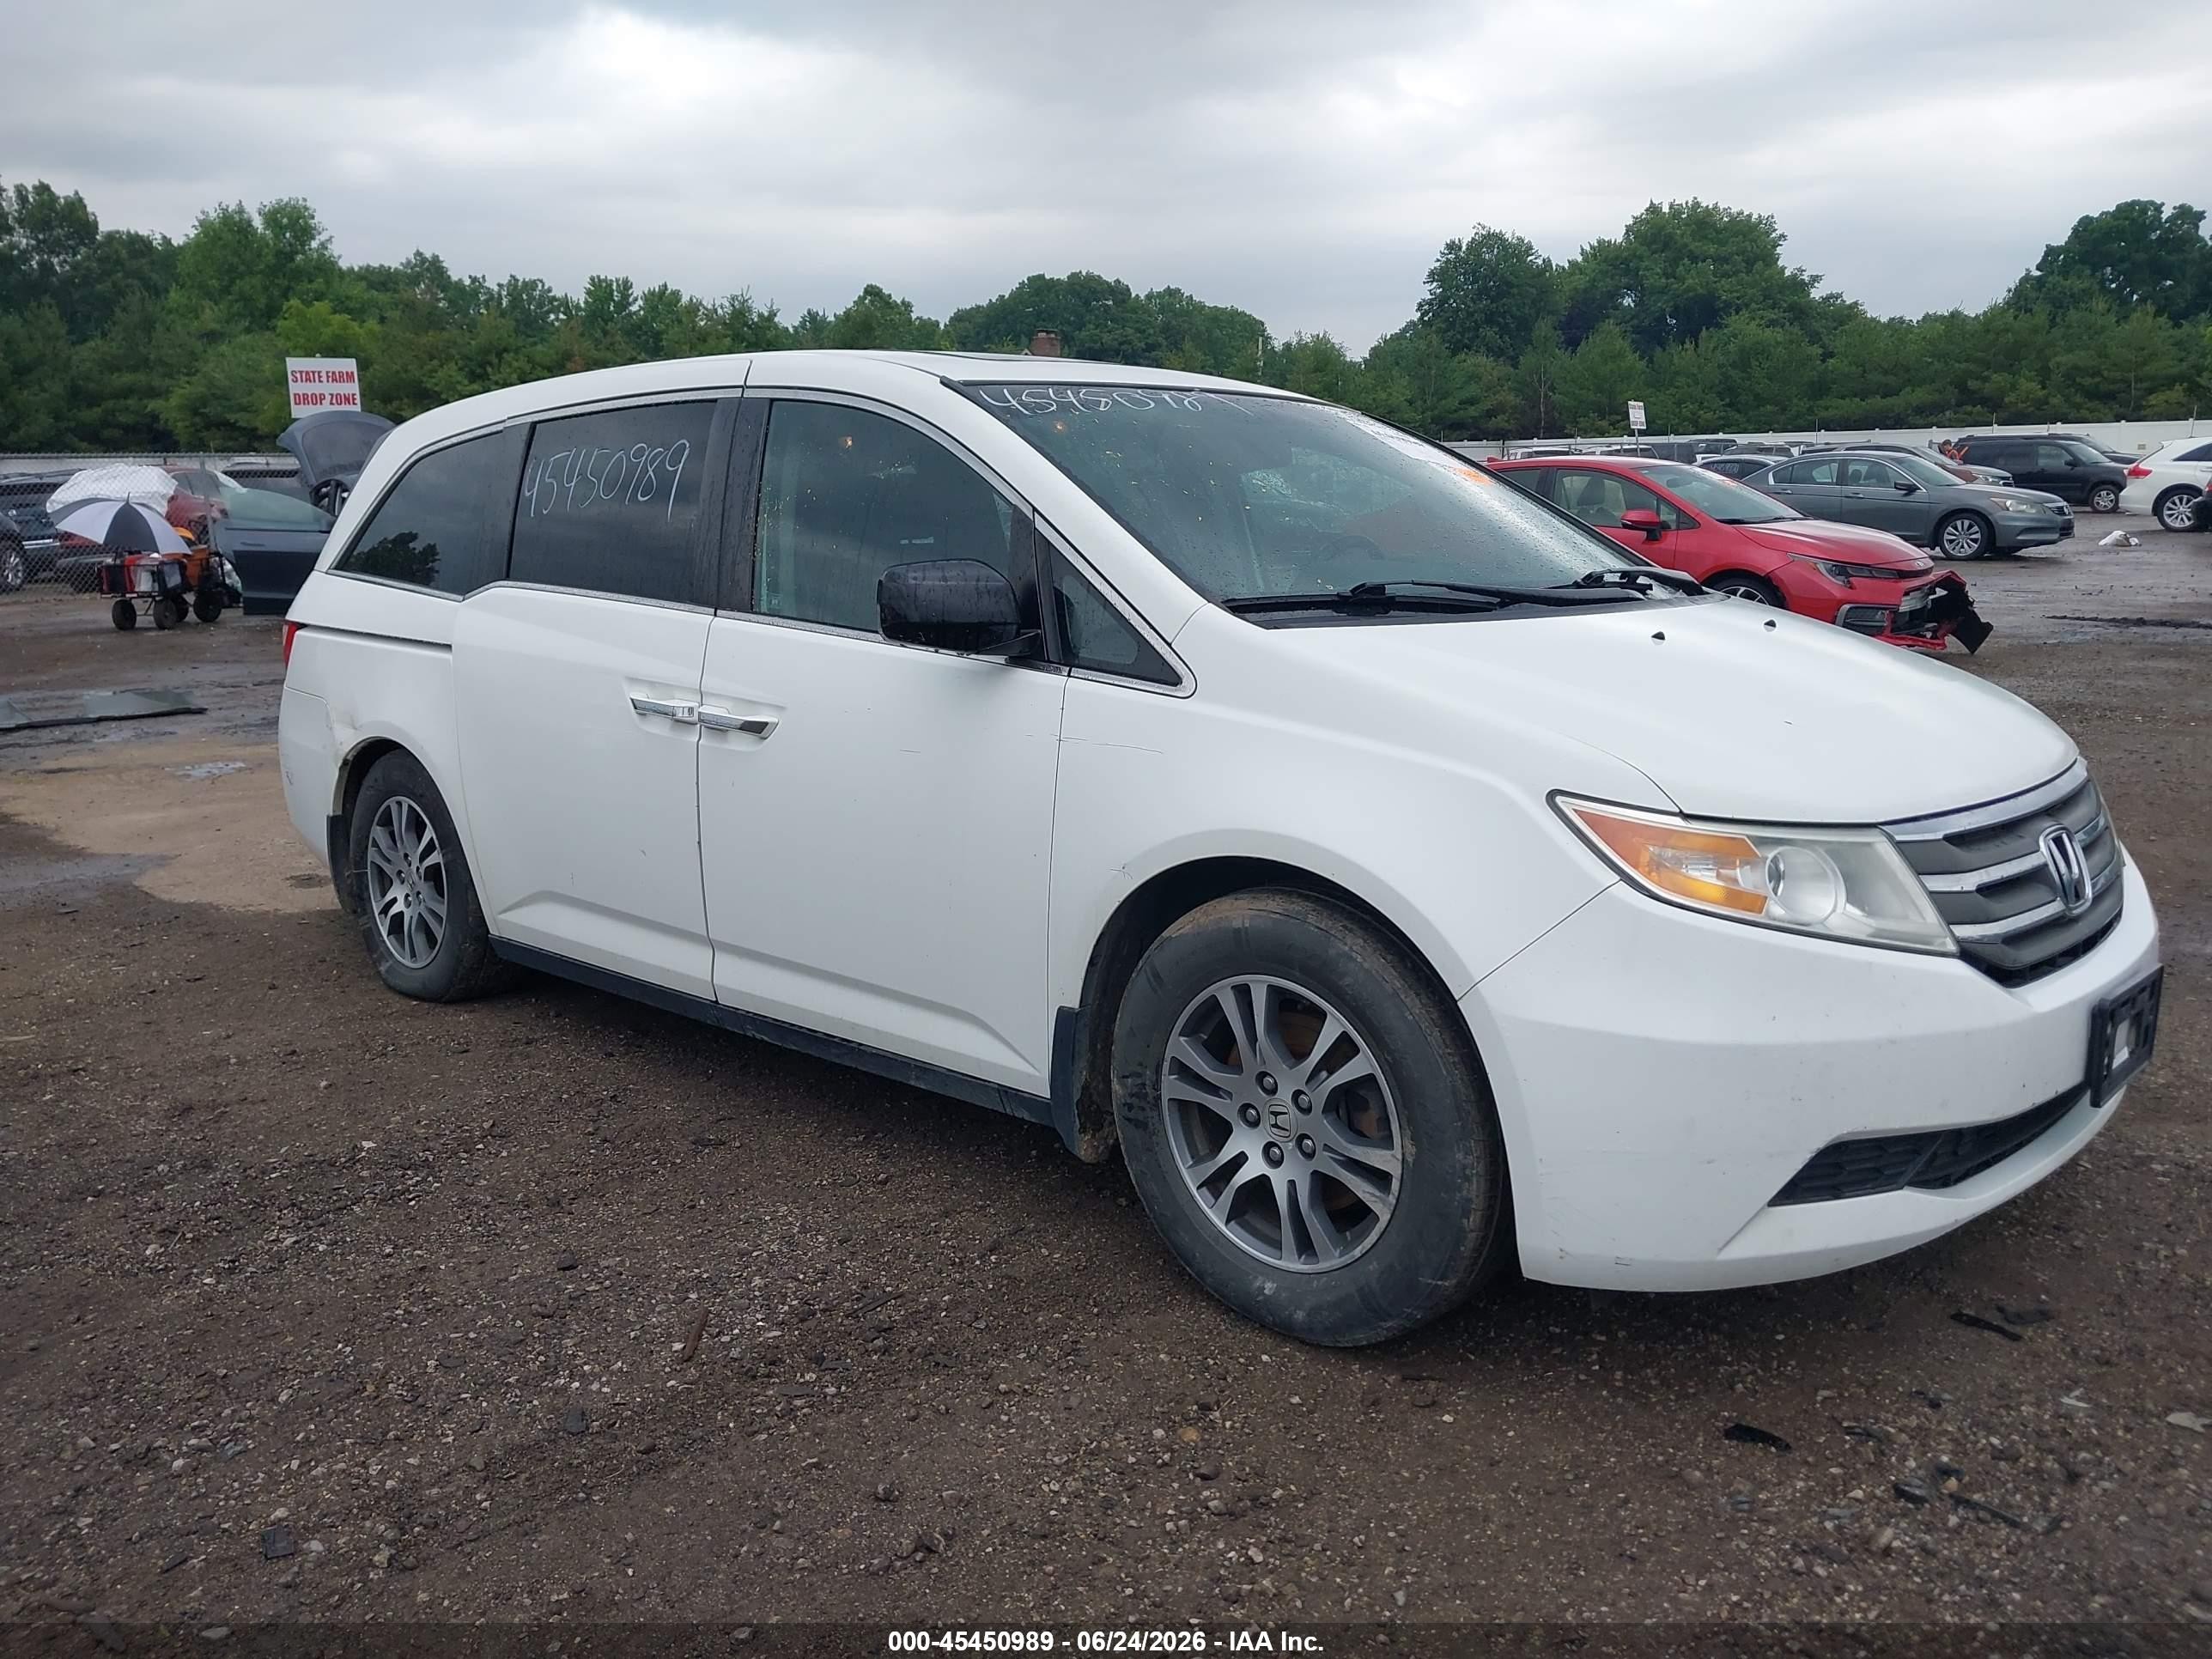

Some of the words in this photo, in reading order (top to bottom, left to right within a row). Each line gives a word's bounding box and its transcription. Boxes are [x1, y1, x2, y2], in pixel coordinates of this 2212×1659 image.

[290, 370, 324, 384] STATE
[326, 370, 356, 385] FARM
[293, 392, 326, 406] DROP
[328, 392, 358, 406] ZONE
[525, 439, 690, 523] 45450989
